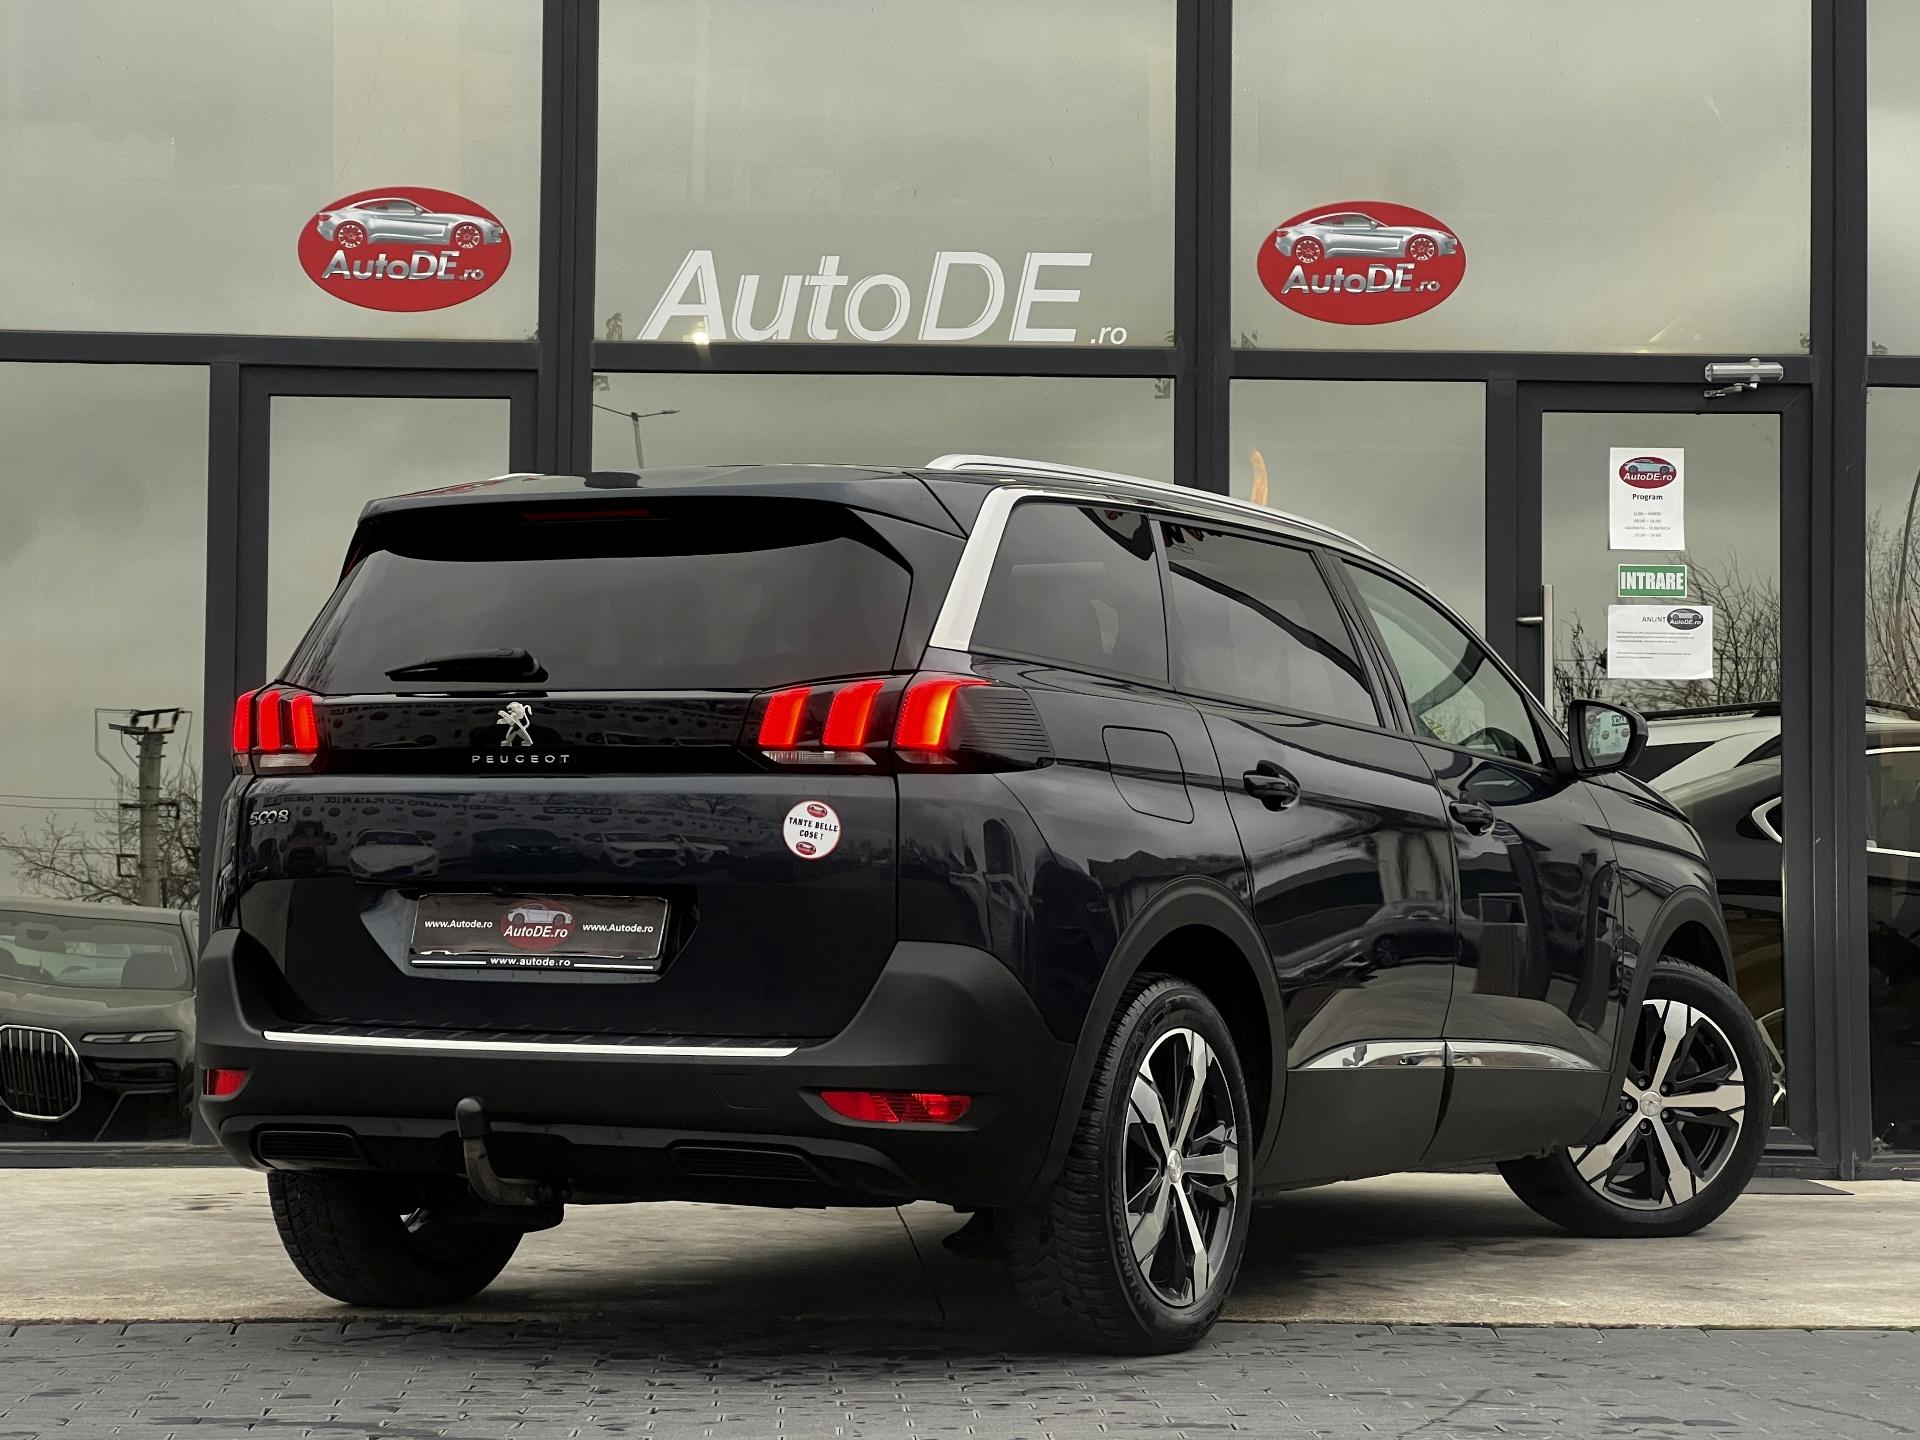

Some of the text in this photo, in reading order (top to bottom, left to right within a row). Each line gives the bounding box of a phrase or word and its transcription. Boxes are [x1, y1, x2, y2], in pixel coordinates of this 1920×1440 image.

[1623, 472, 1673, 481] AutoDE.ro
[1632, 493, 1663, 501] Program
[1620, 571, 1684, 590] INTRARE
[471, 754, 571, 764] PEUGEOT
[249, 809, 289, 826] 5008
[789, 816, 838, 832] TANTE BELLE
[799, 829, 818, 839] COSE
[424, 920, 493, 929] www.Autode.ro
[582, 923, 654, 933] www.Autode.ro
[503, 925, 569, 938] AutoDE.ro
[490, 957, 571, 967] www.autode.ro
